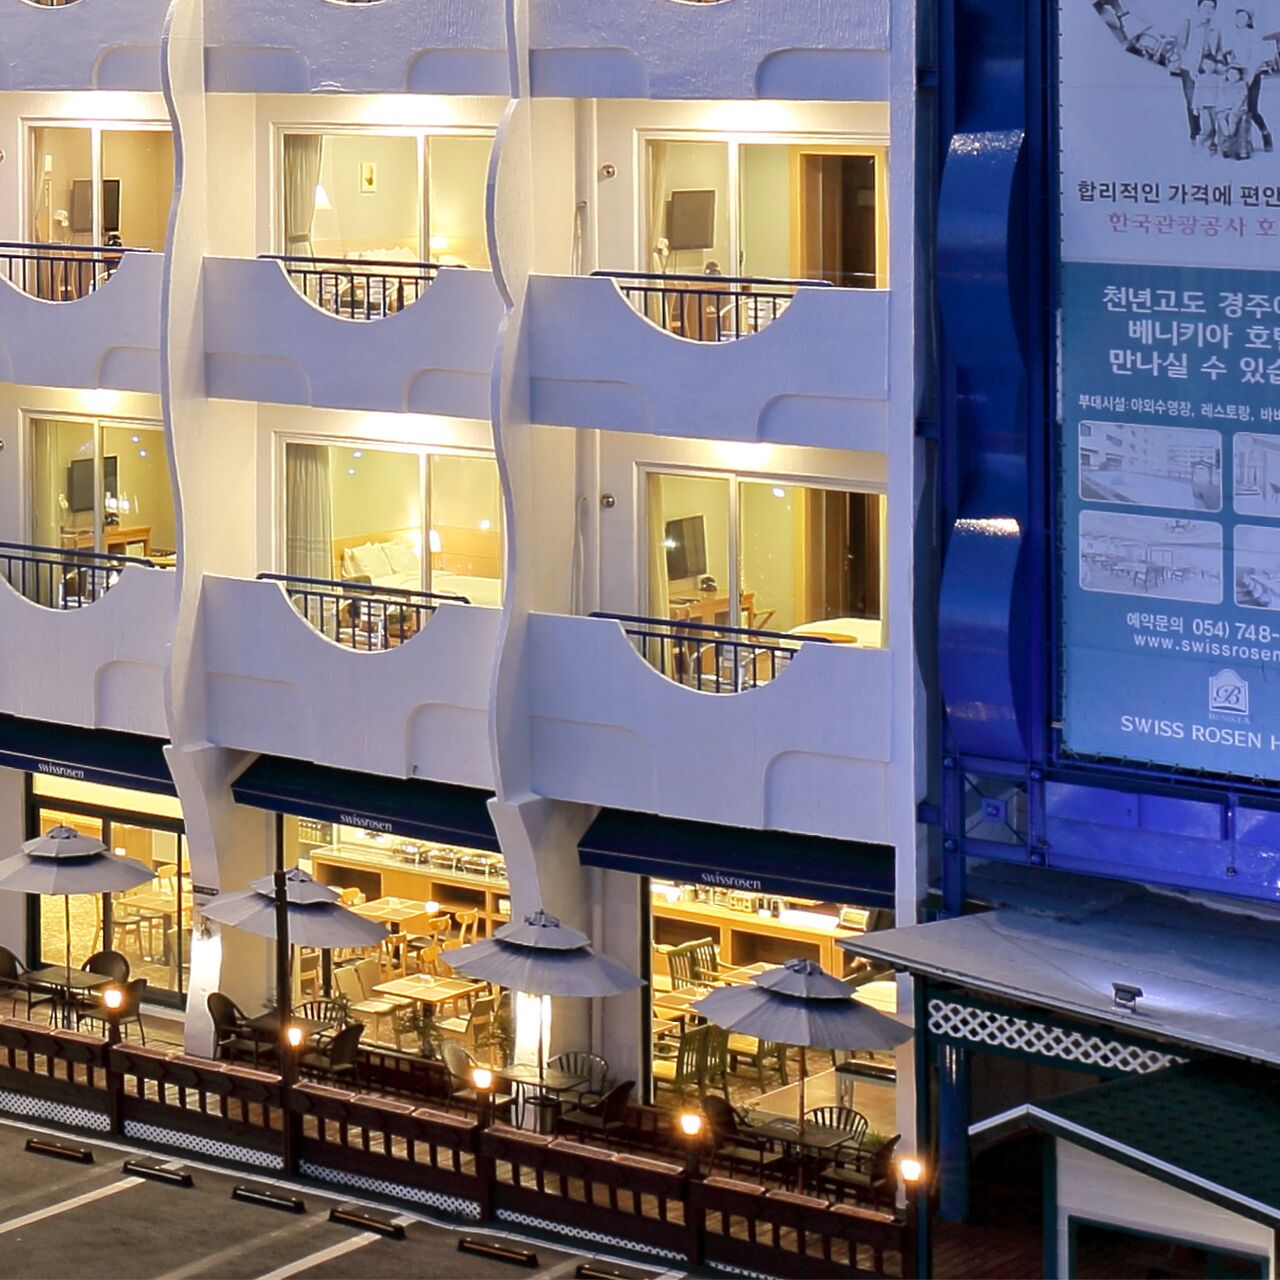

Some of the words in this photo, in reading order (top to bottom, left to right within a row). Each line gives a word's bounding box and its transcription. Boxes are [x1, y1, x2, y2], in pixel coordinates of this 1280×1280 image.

[1077, 180, 1160, 204] 합리적인
[1168, 183, 1233, 207] 가격에
[1107, 211, 1248, 238] 한국관광공사
[1102, 285, 1207, 313] 천년고도
[1218, 291, 1280, 320] 경주
[1128, 319, 1233, 350] 베니키아
[1108, 348, 1188, 379] 만나실
[1200, 355, 1228, 381] 수
[1126, 611, 1184, 635] 예약문의
[1192, 618, 1230, 640] 054)
[1120, 714, 1185, 739] SWISS
[1192, 723, 1262, 750] ROSEN
[701, 871, 762, 890] swissrosen
